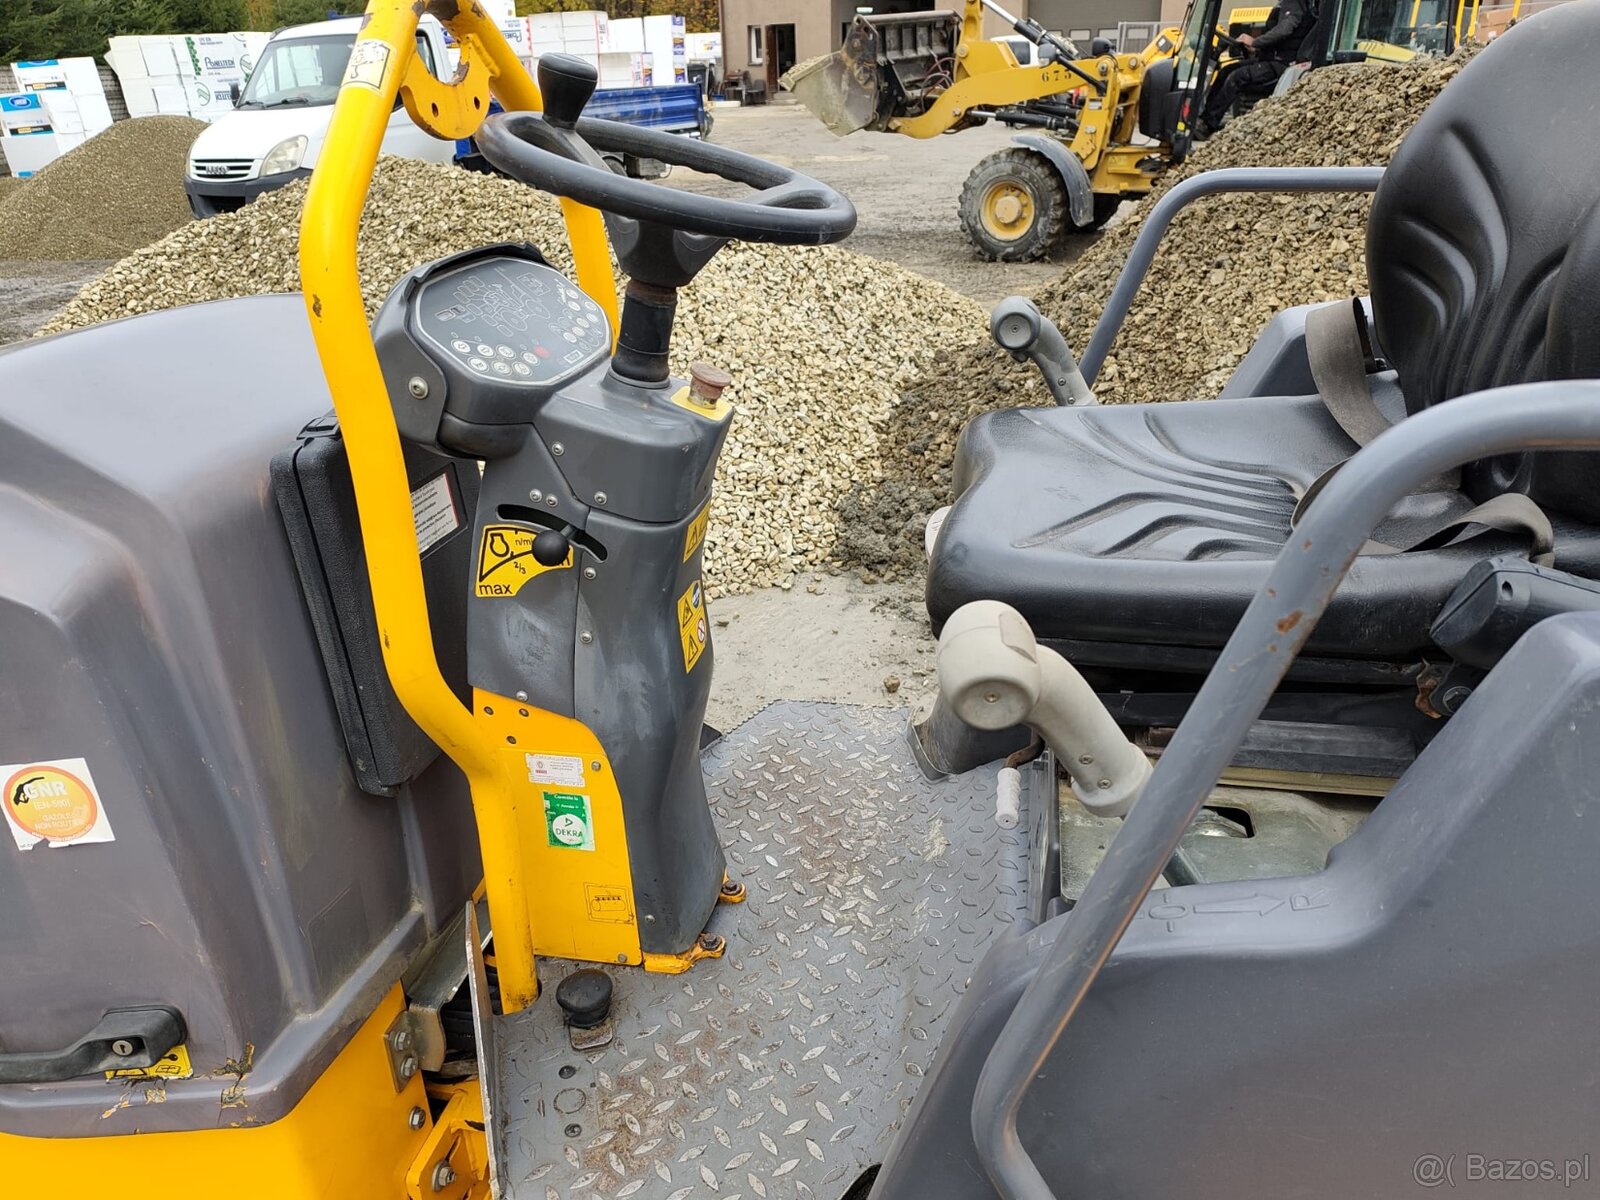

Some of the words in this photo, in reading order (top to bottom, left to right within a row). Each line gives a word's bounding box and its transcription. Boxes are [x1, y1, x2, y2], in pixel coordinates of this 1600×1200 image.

[479, 584, 513, 595] max
[23, 781, 68, 799] GNR
[555, 828, 583, 838] DEKRA
